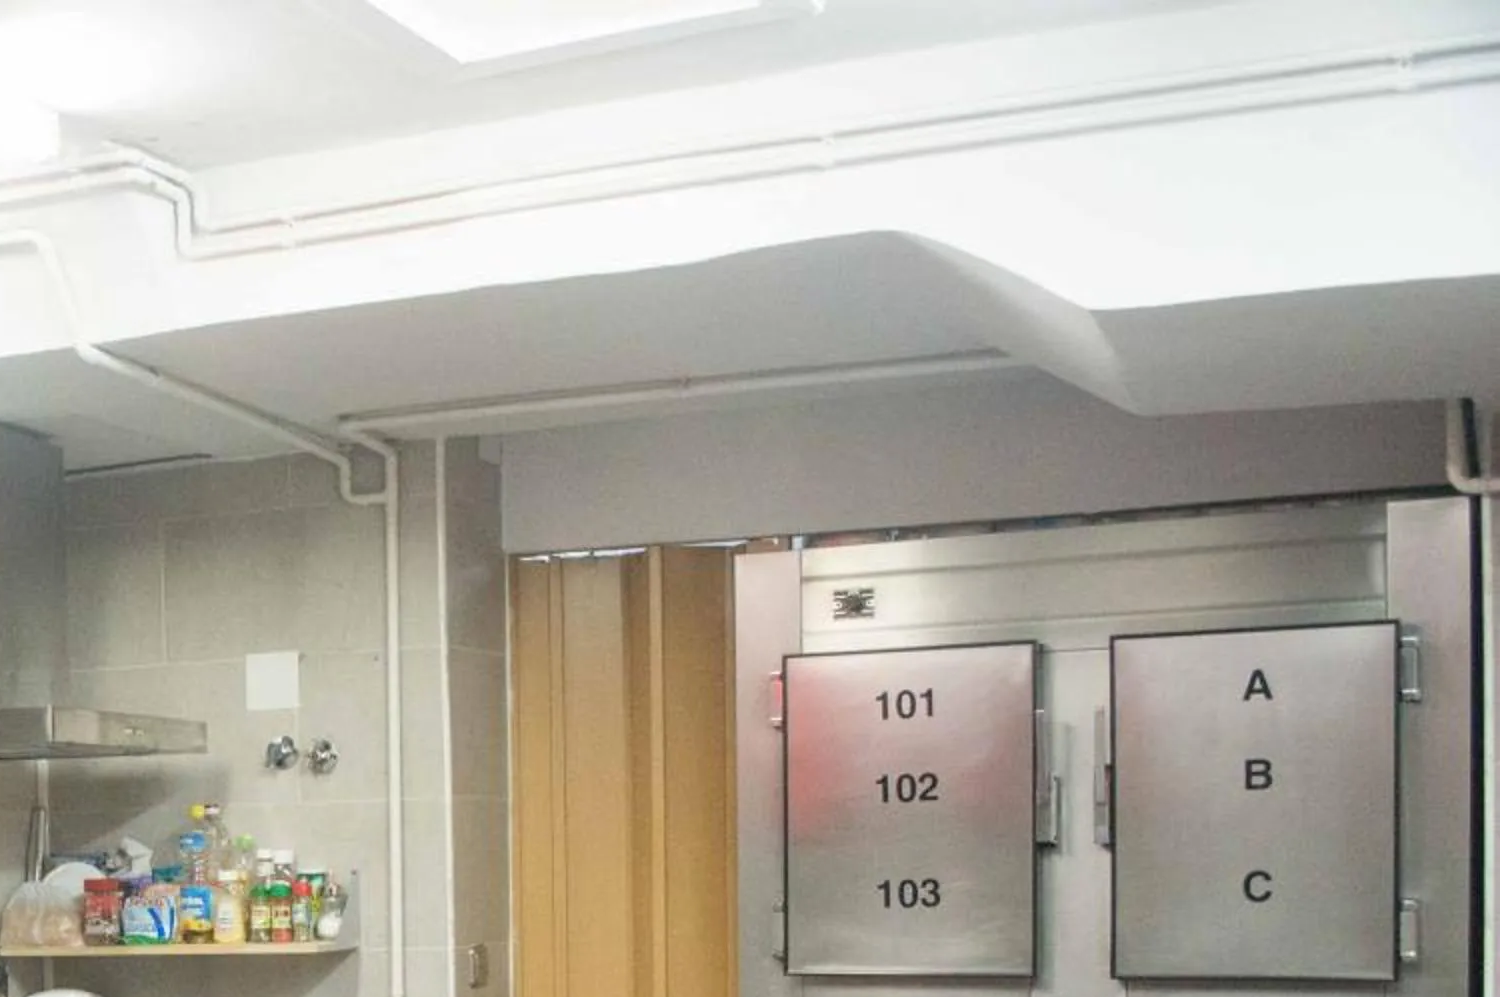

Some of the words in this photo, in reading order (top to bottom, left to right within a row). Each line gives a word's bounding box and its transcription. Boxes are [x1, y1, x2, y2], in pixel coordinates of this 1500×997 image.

[1243, 668, 1274, 702] A
[875, 687, 935, 721] 101
[875, 771, 939, 804] 102
[1244, 758, 1273, 791] B
[877, 877, 941, 909] 103
[1243, 869, 1273, 903] C
